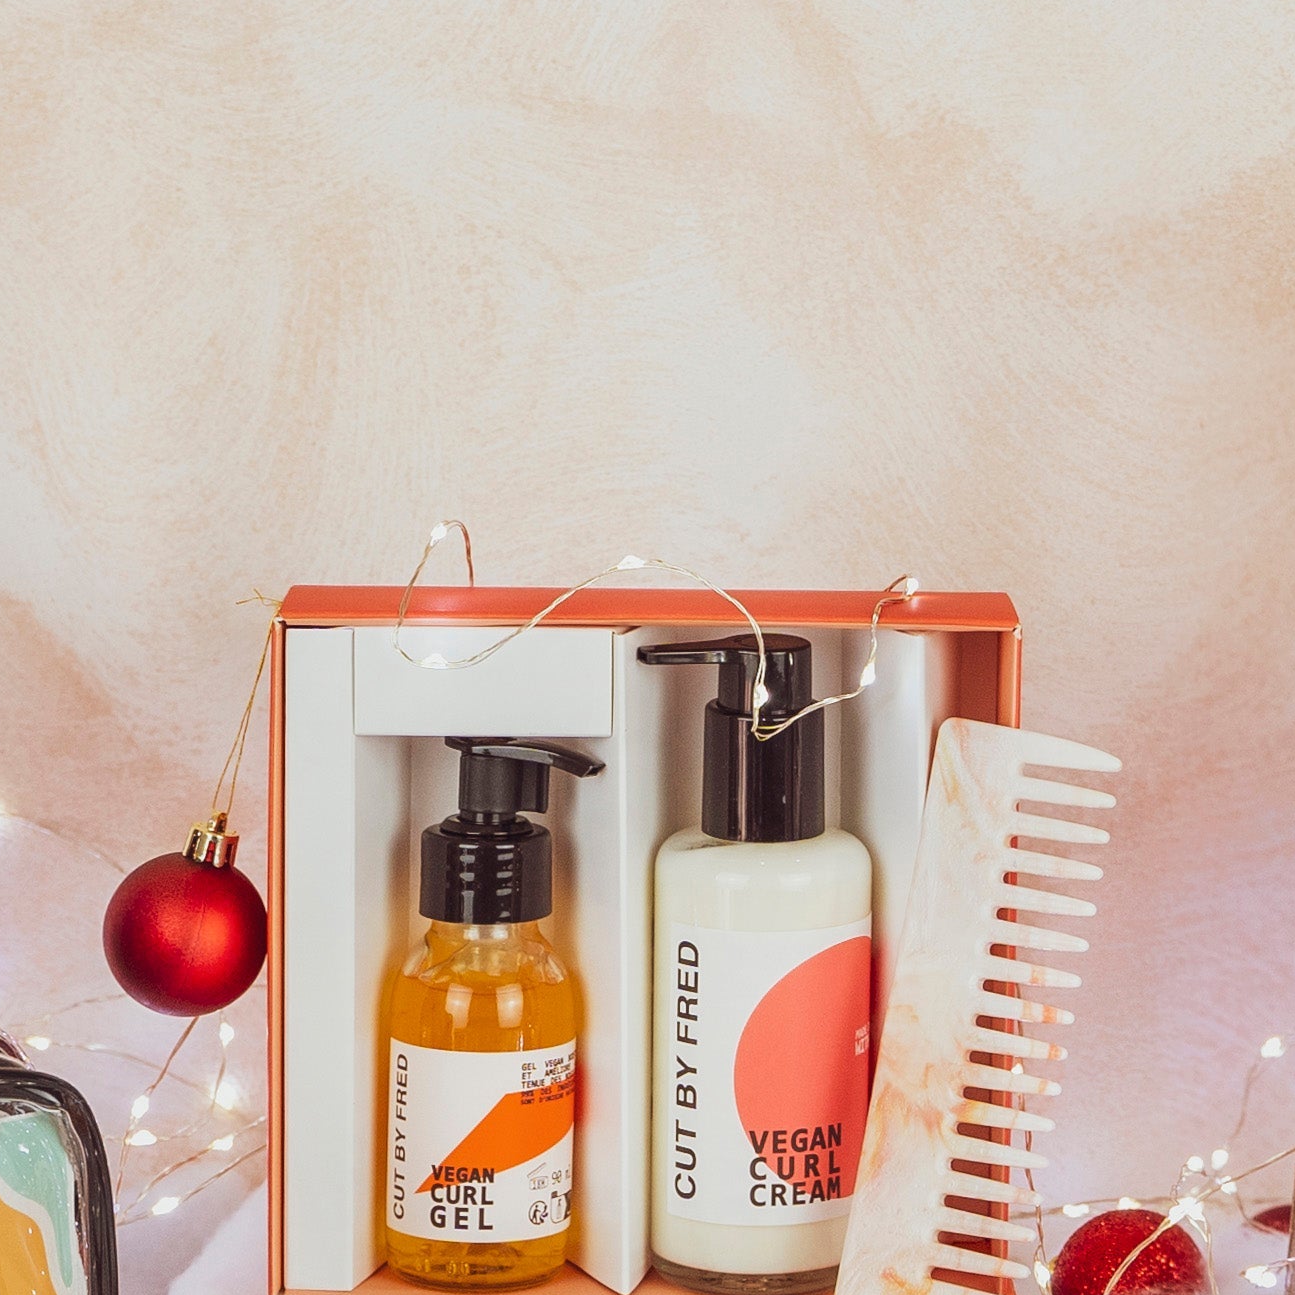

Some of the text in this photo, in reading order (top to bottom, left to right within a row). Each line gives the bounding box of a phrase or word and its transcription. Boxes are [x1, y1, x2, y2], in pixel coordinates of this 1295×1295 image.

[675, 941, 699, 1200] CUT BY FRED
[393, 1054, 408, 1220] CUT BY FRED
[749, 1123, 842, 1154] VEGAN
[431, 1165, 494, 1183] VEGAN
[749, 1151, 840, 1181] CURL
[431, 1184, 493, 1205] CURL
[749, 1176, 840, 1206] CREAM
[430, 1206, 493, 1230] GEL
